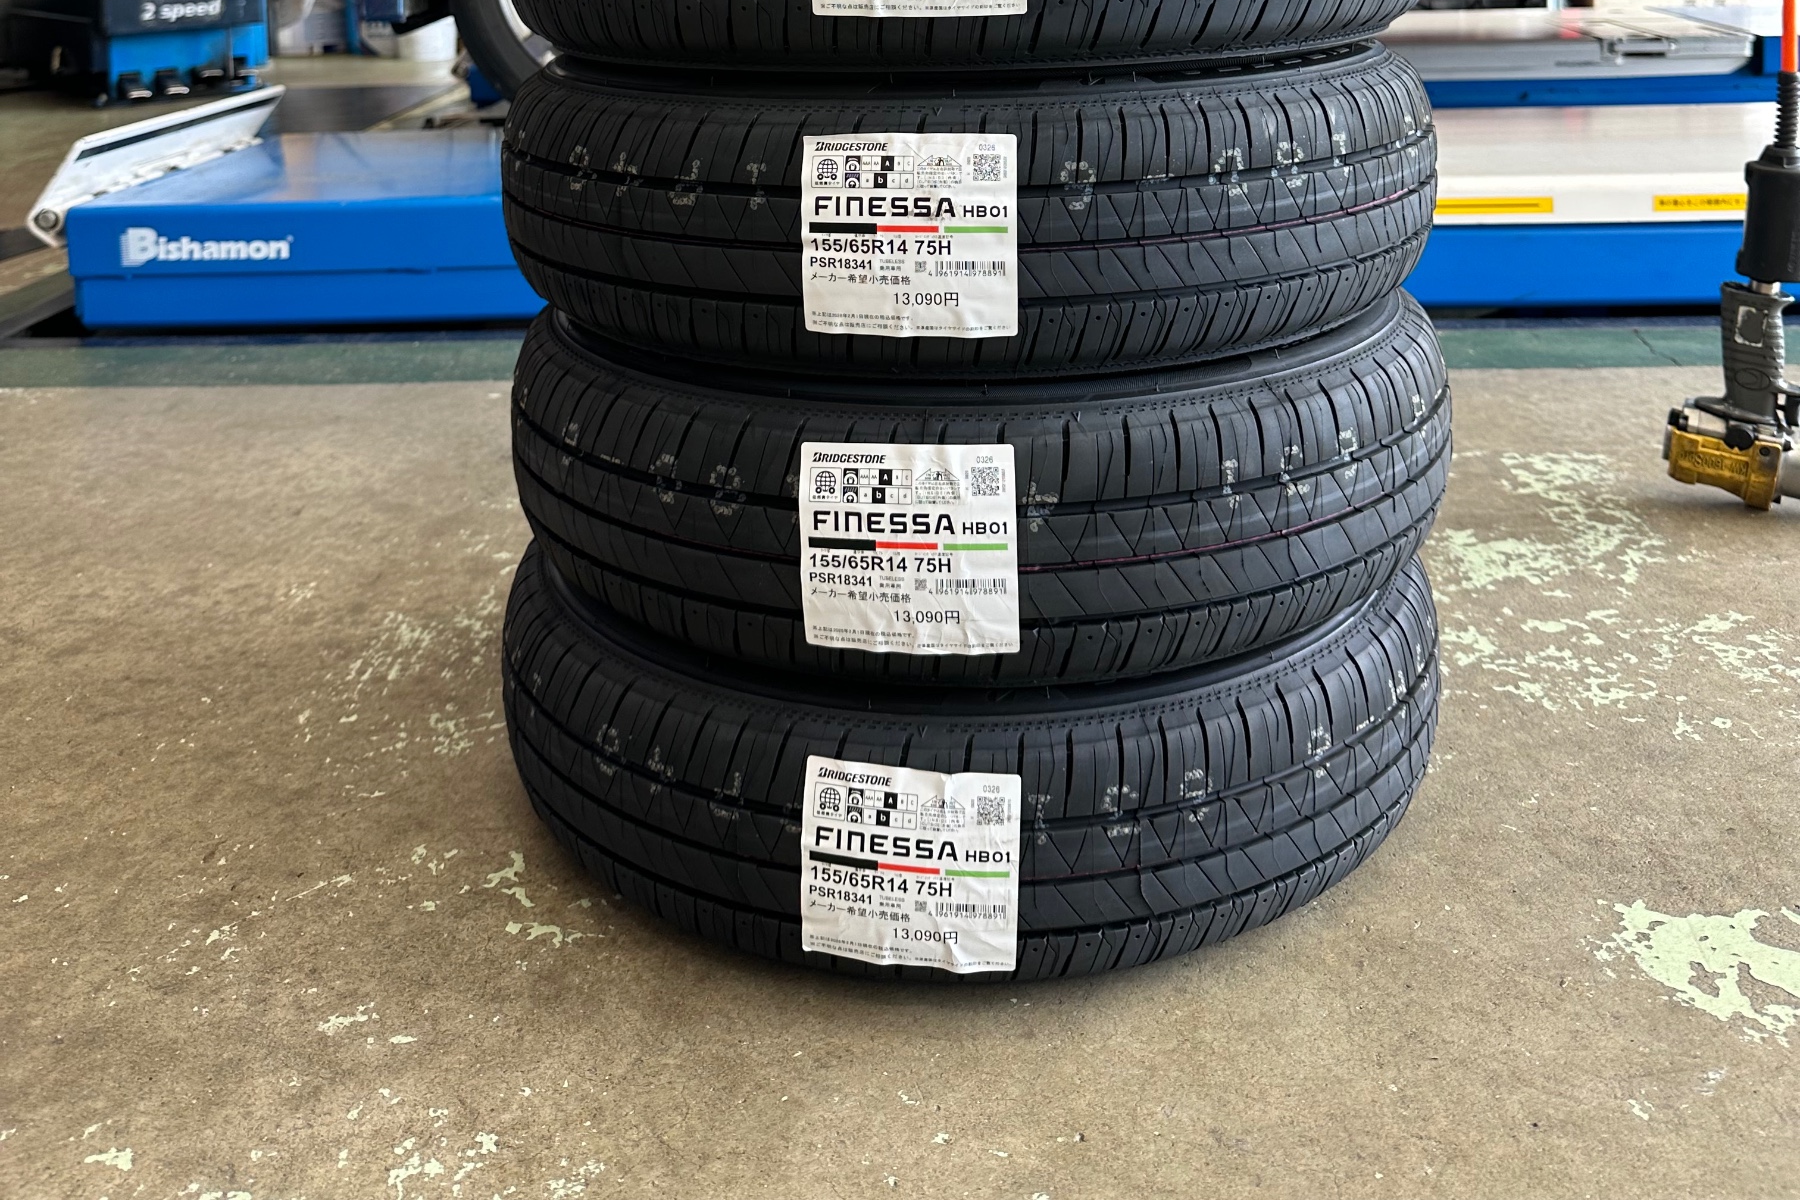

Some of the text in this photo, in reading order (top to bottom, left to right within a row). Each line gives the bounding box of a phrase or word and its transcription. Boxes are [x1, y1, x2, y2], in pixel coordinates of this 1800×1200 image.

[141, 1, 156, 21] 2
[814, 142, 888, 151] BRIDGESTONE
[877, 175, 883, 183] b
[814, 196, 1008, 218] FINESSA HB01
[119, 227, 290, 267] Bishamon
[810, 239, 951, 255] 155/65R14 75H
[810, 257, 872, 270] PSR18341
[810, 273, 911, 285] メーカー希望小売価格
[893, 292, 959, 306] 13,090円
[812, 452, 886, 464] BRIDGESTONE
[813, 510, 1008, 535] FINESSA HB01
[810, 554, 951, 573] 155/65R14 75H
[809, 572, 872, 586] PSR18341
[811, 588, 911, 603] メーカー希望小売価格
[894, 610, 960, 624] 13,090円
[818, 767, 892, 787] BRIDGESTONE
[983, 785, 1000, 793] 0326
[880, 813, 886, 821] b
[815, 825, 1010, 863] FINESSA HB01
[811, 865, 908, 894] 155/65R14
[916, 881, 952, 897] 75H
[810, 885, 872, 904] PSR18341
[810, 900, 910, 923] メーカー希望小売価格
[893, 927, 958, 944] 13,090円
